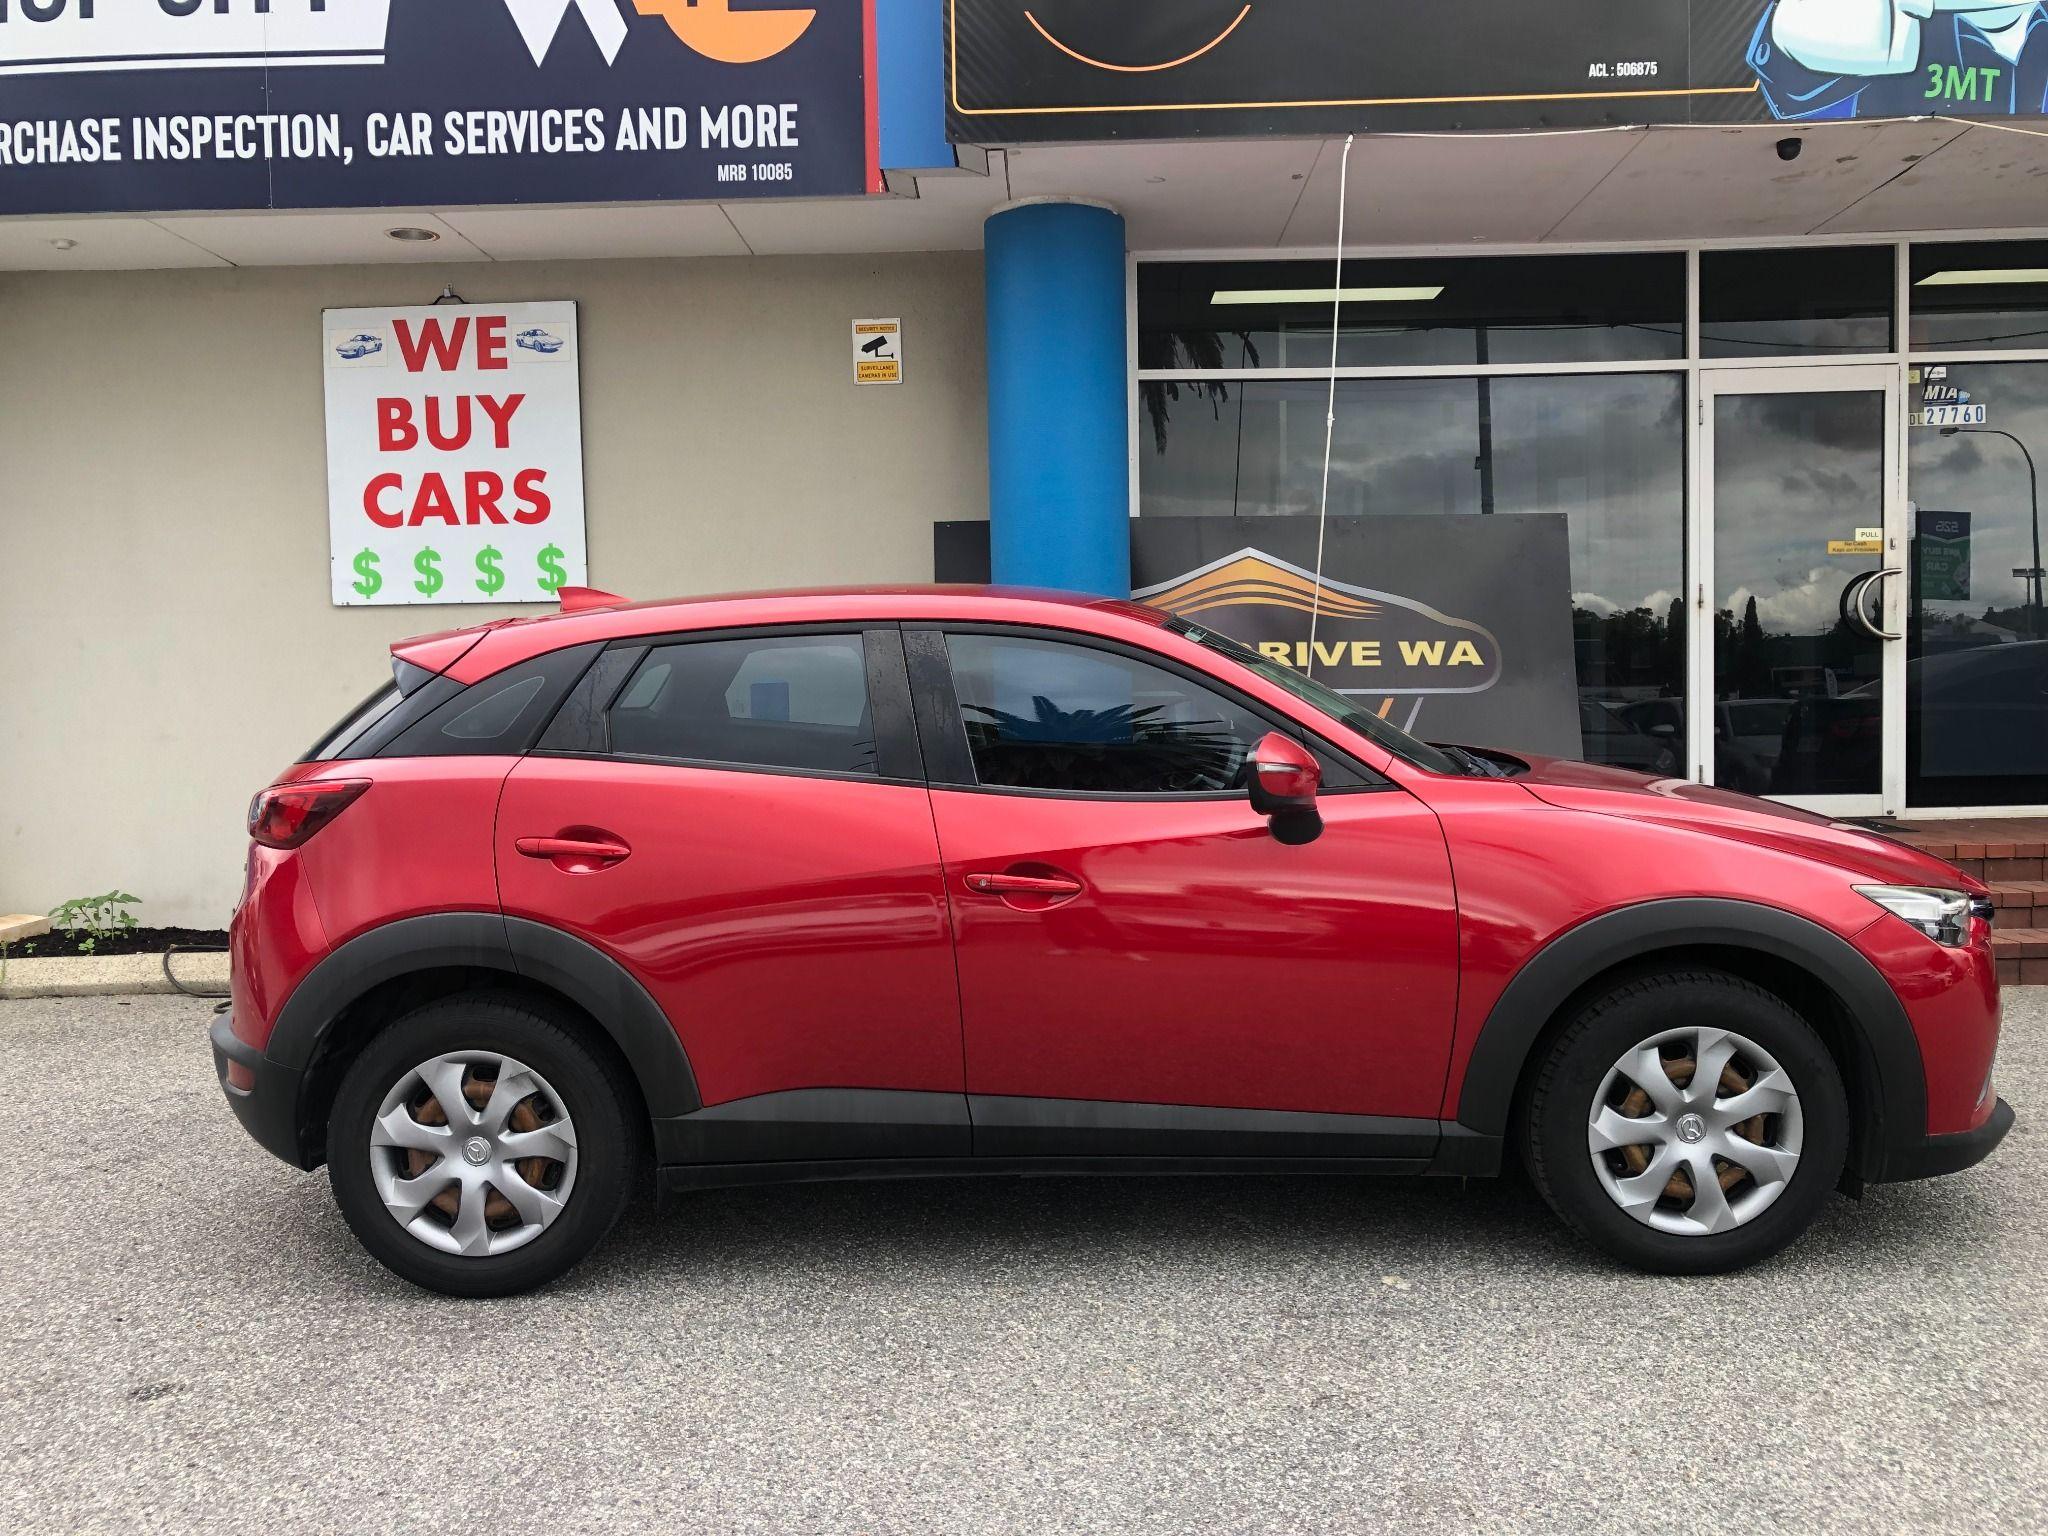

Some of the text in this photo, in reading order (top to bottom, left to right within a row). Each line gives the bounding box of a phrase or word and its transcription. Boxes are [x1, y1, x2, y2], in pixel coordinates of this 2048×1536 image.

[1588, 63, 1609, 77] ACL
[1617, 61, 1658, 76] 506875
[1924, 63, 2001, 102] 3MT
[133, 113, 353, 165] INSPECTION,
[366, 112, 433, 158] CAR
[445, 108, 605, 155] SERVICES
[615, 106, 687, 151] AND
[700, 103, 799, 149] MORE
[717, 162, 793, 182] MRB 10085
[392, 315, 508, 372] WE
[376, 393, 526, 452] BUY
[1926, 405, 1984, 425] 27760
[363, 468, 551, 529] CARS
[1242, 640, 1485, 666] RIVE WA
